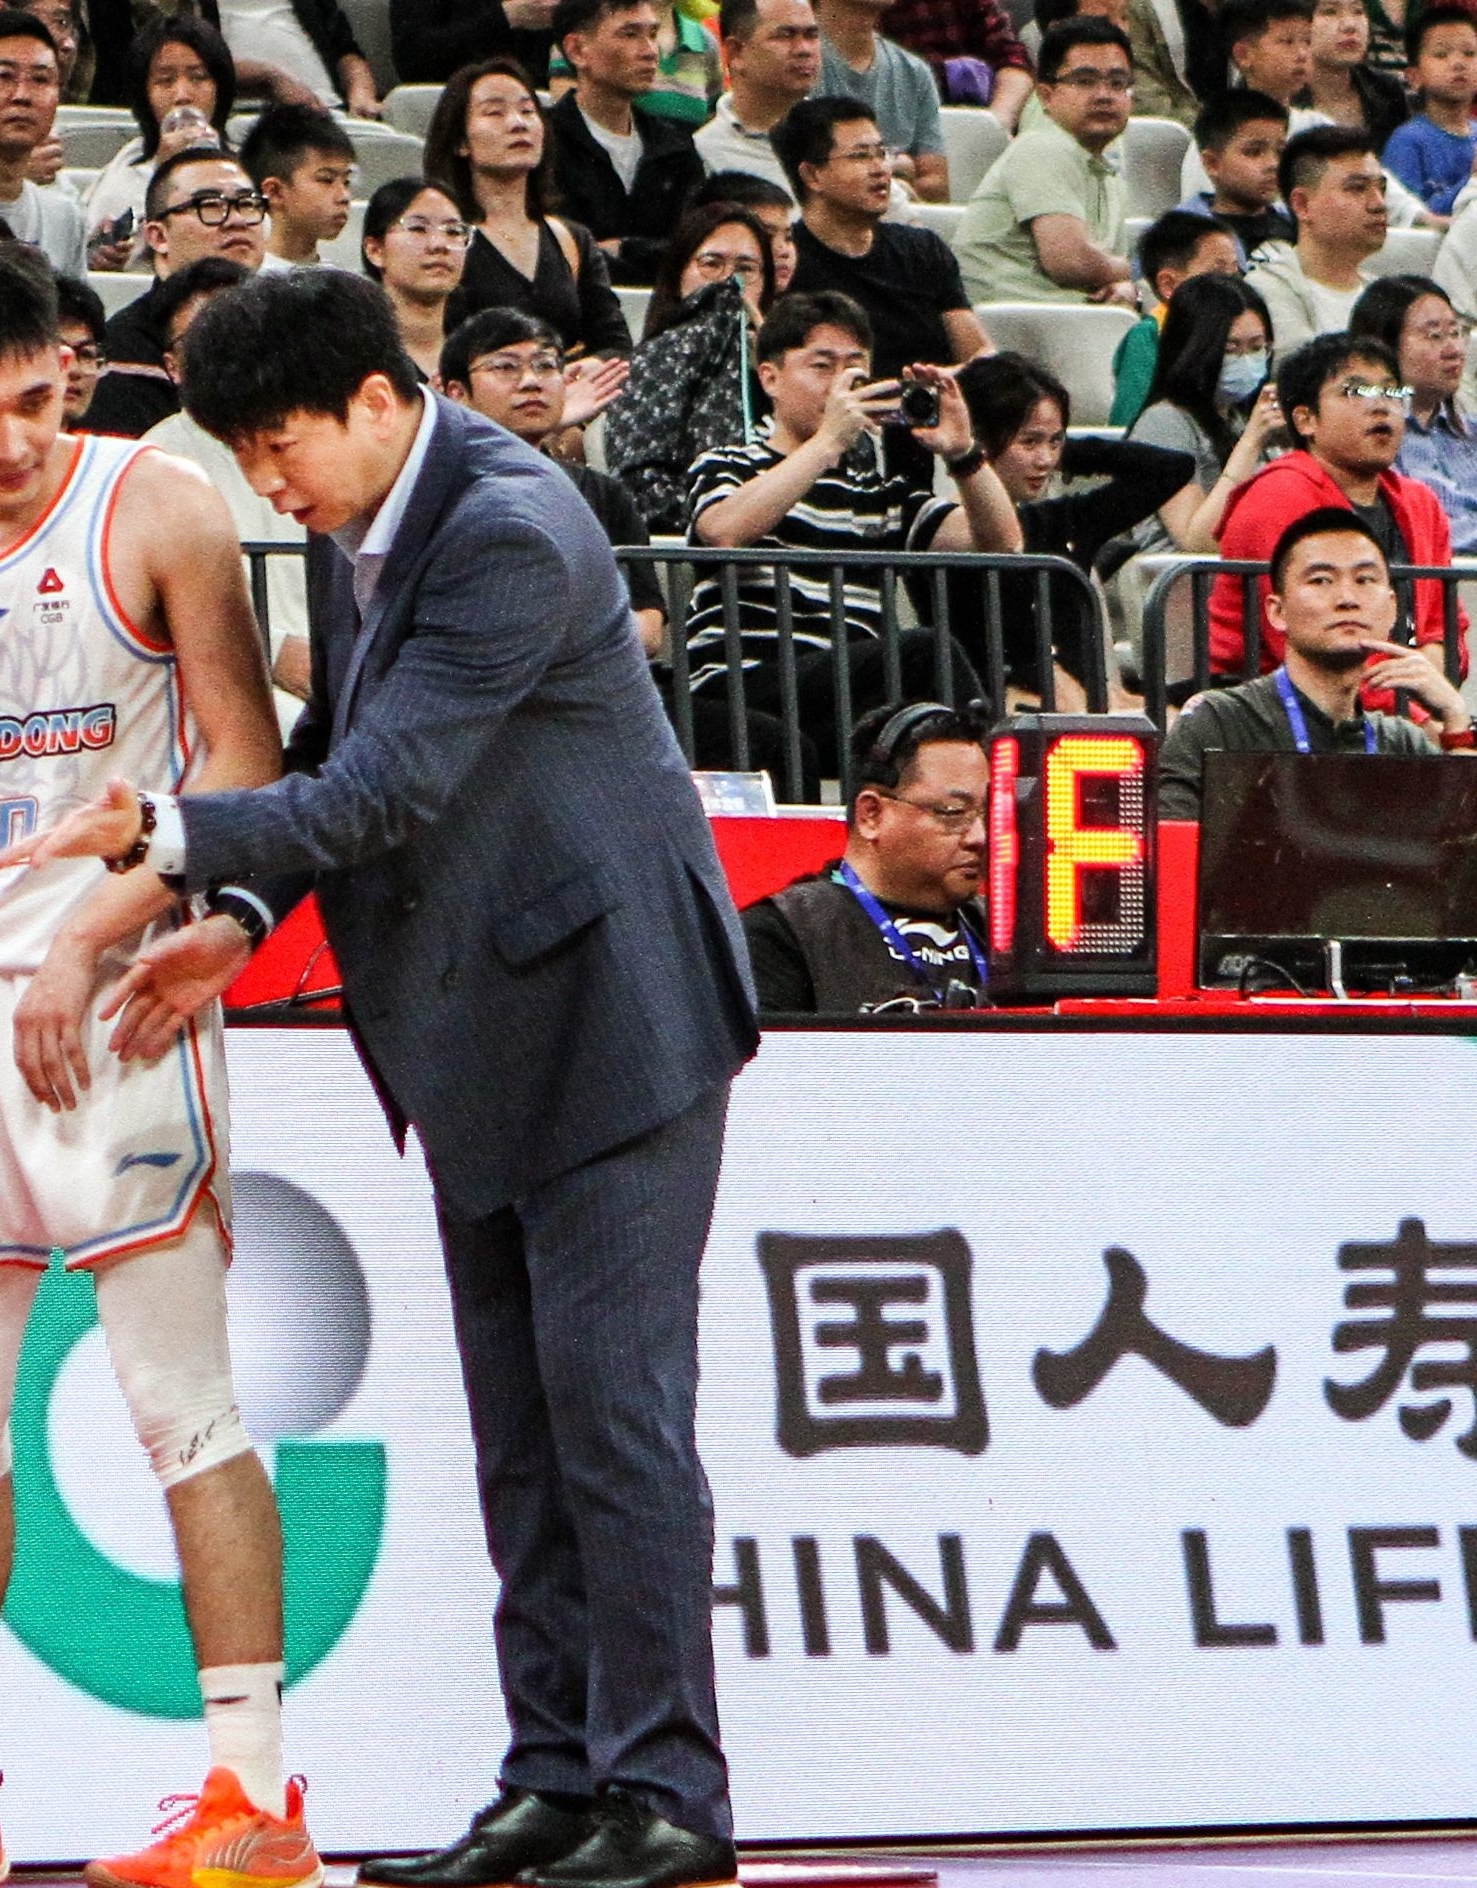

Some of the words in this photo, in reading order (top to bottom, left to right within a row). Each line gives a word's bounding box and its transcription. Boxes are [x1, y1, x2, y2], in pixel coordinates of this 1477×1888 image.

[884, 941, 970, 966] L-NING
[755, 1216, 1477, 1460] 国人寿
[712, 1529, 1118, 1659] HINA
[1181, 1523, 1477, 1647] LIF
